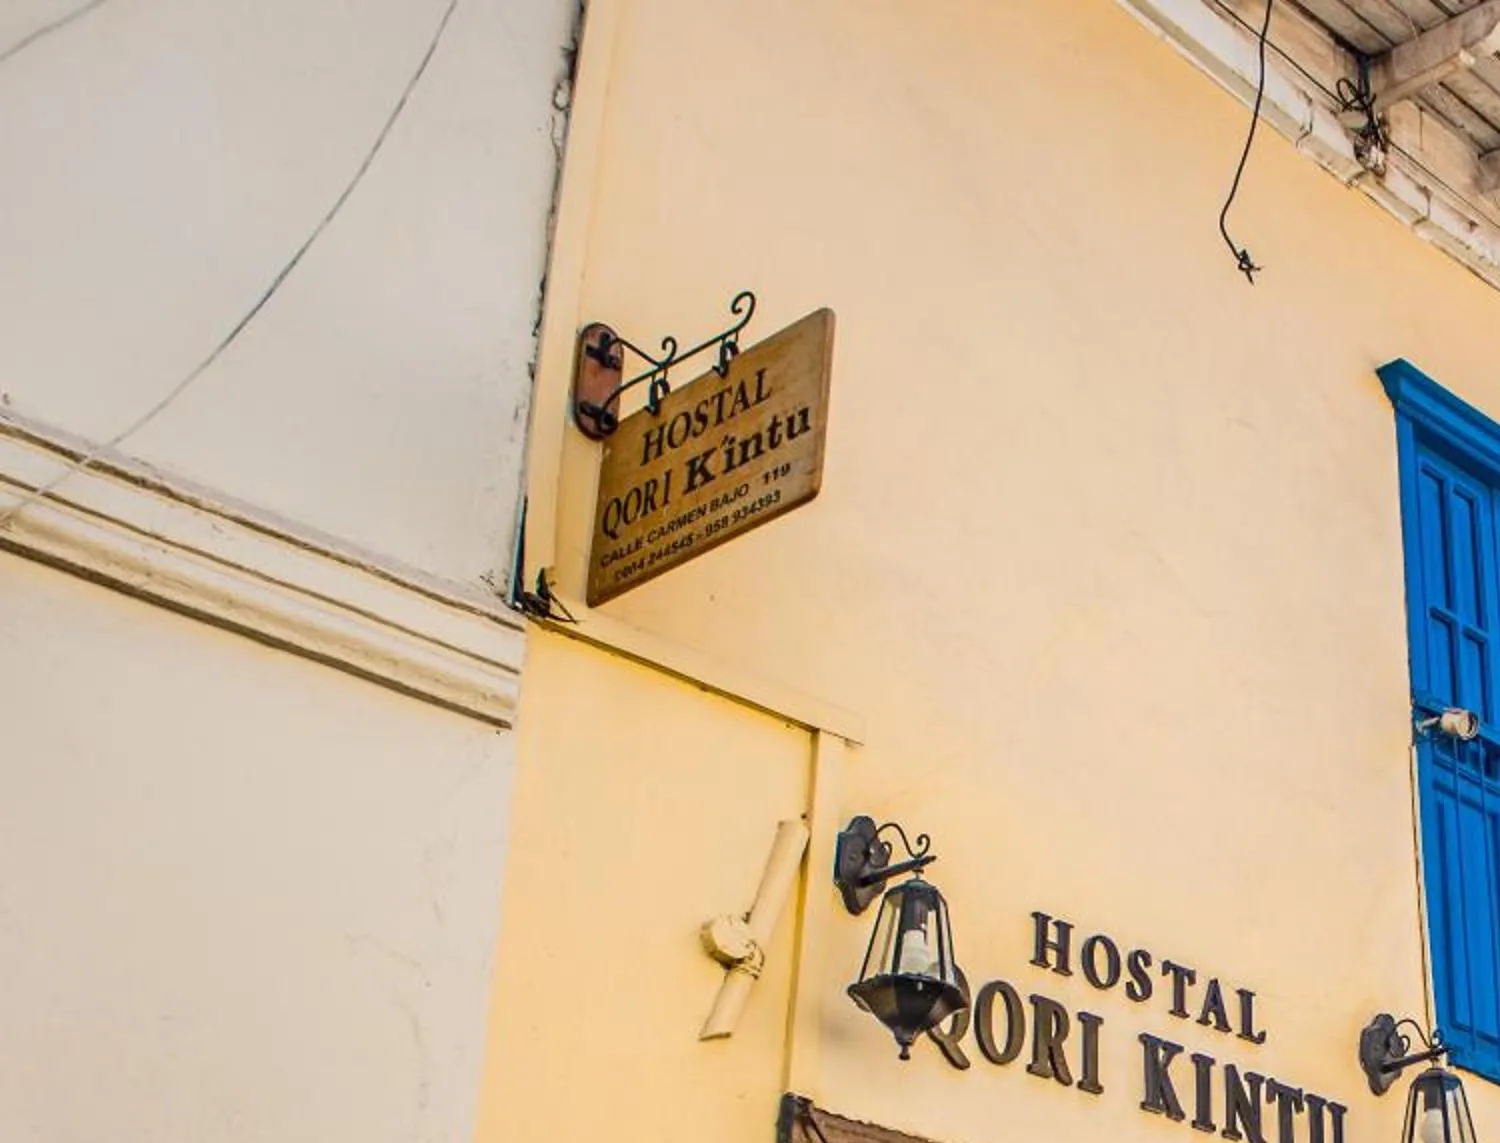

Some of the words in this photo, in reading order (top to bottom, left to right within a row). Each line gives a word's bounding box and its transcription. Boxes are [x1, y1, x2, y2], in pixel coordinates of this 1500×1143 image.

[640, 367, 773, 467] HOSTAL
[602, 469, 672, 540] QORI
[647, 503, 707, 543] CARMEN
[710, 483, 750, 513] BAJO
[763, 463, 791, 485] 119
[1030, 911, 1267, 1045] HOSTAL
